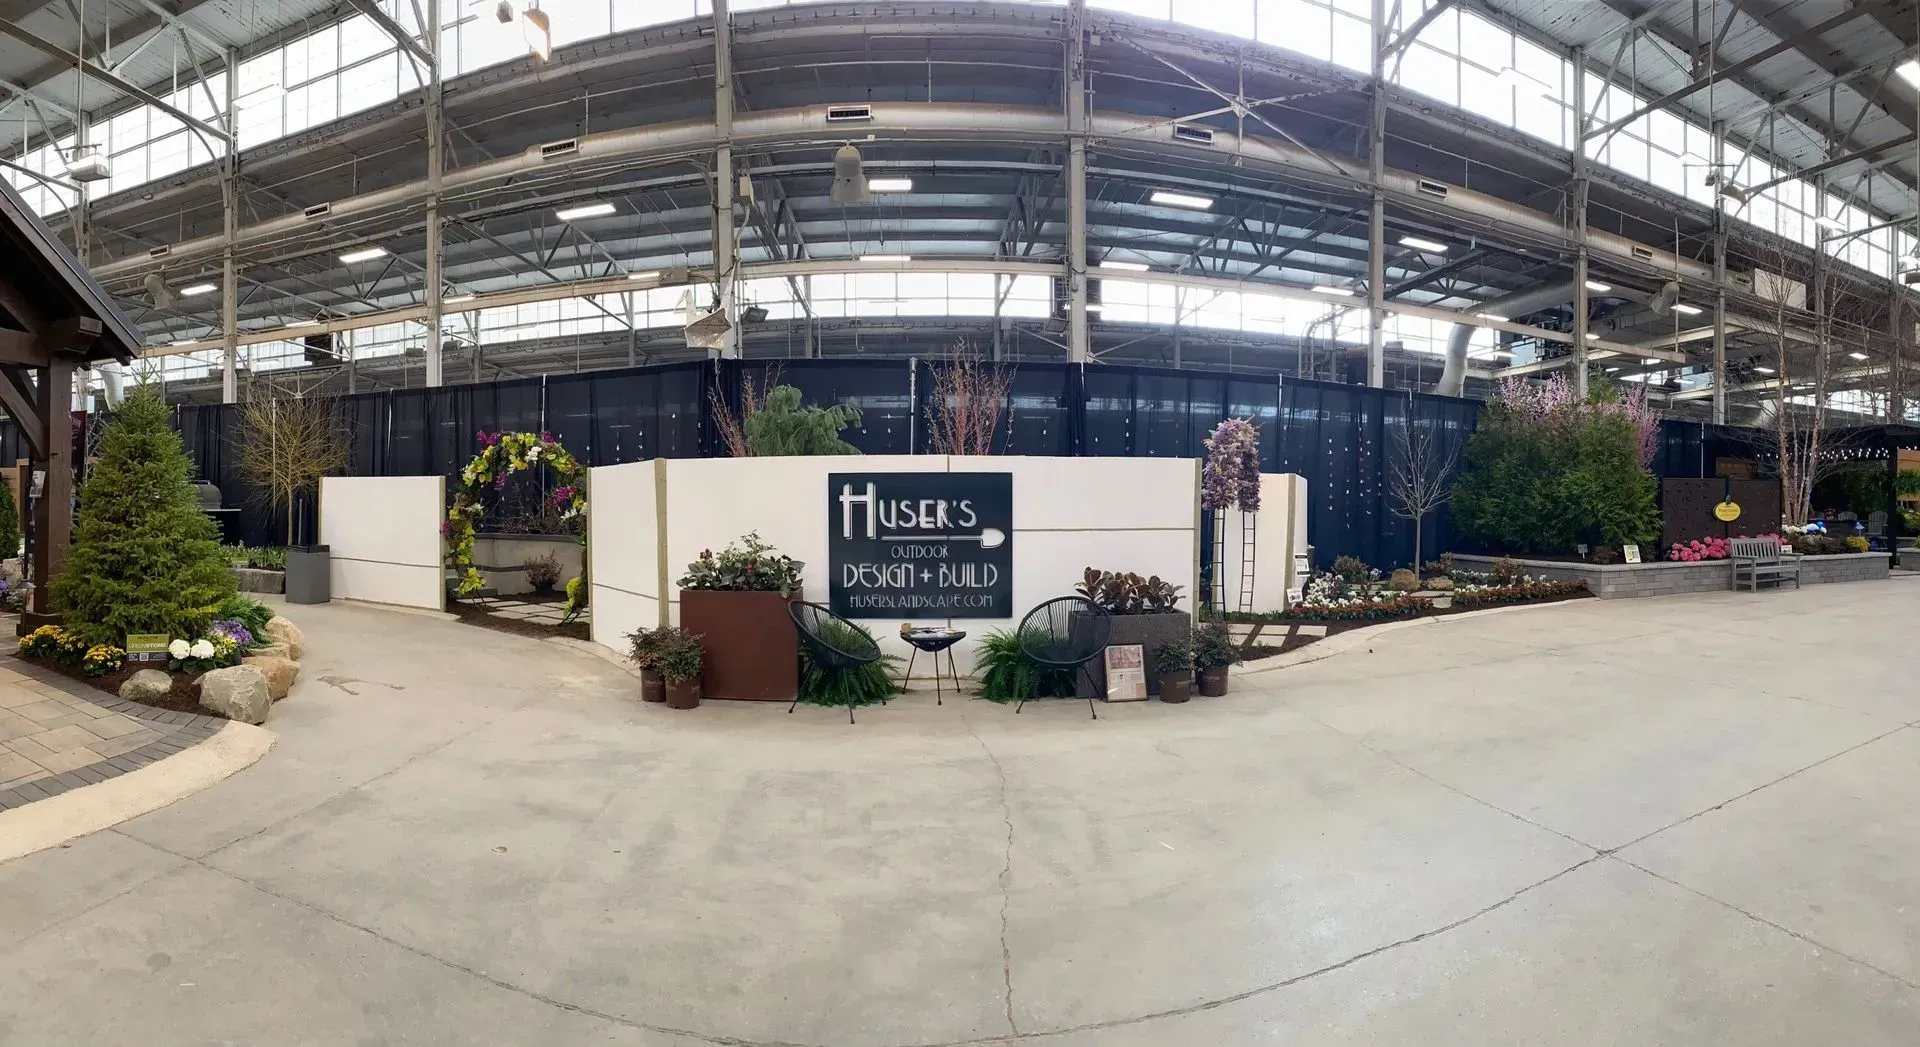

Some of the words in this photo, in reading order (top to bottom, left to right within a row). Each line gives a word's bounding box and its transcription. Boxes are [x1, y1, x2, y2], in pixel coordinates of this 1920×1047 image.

[839, 482, 978, 540] HUSER'S
[891, 544, 949, 559] OUTDOOR
[843, 563, 914, 588] DESIGN
[919, 568, 933, 583] +
[939, 562, 998, 588] BUILD
[850, 593, 993, 609] HUSERSLANDSCAPE.COM
